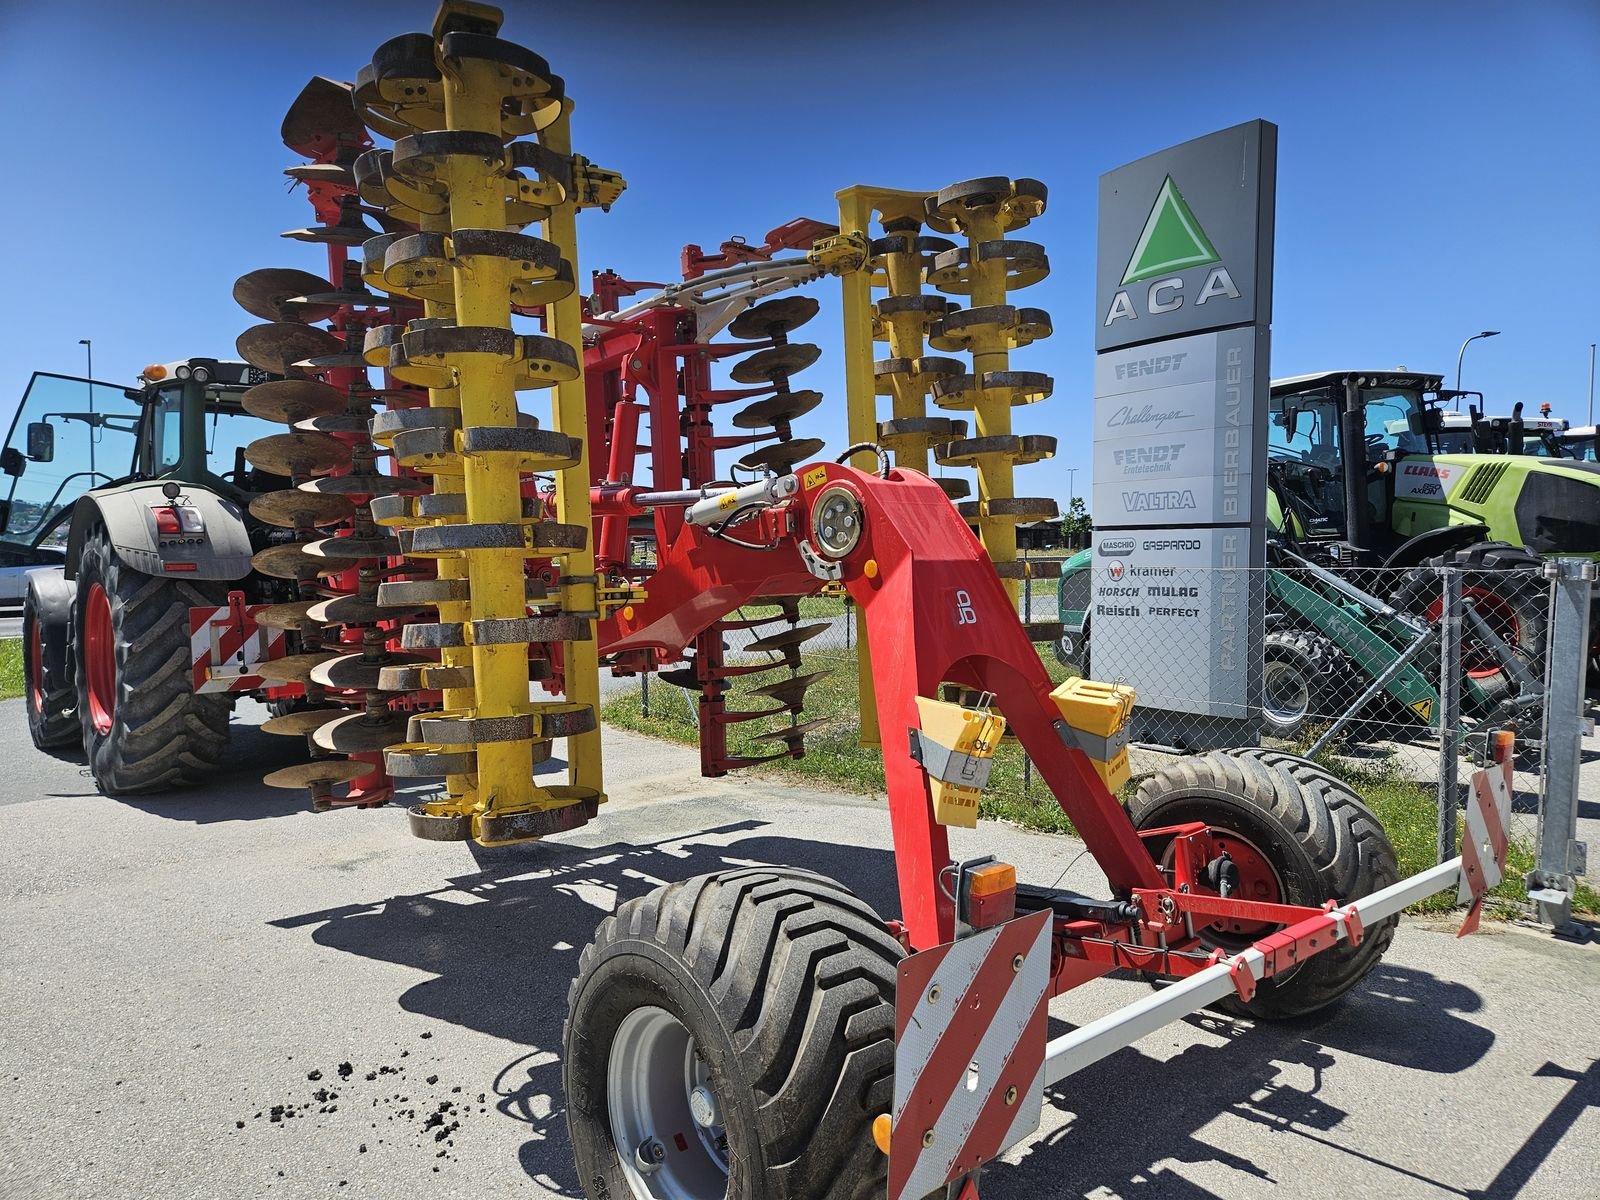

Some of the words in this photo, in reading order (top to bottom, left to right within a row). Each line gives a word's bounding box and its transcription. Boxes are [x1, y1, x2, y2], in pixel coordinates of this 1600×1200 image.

[1104, 266, 1242, 327] ACA
[1115, 353, 1187, 380] FENDT
[1106, 406, 1196, 429] Challenger
[1223, 346, 1241, 517] BIERBAUER
[1113, 444, 1186, 466] FENDT
[1123, 462, 1171, 475] Erntetechnik
[1404, 465, 1451, 479] CLAAS
[1410, 487, 1438, 496] AXION
[1122, 490, 1196, 512] VALTRA
[1103, 541, 1135, 549] MASCHIO
[1143, 540, 1201, 551] GASPARDO
[1130, 564, 1176, 577] kramer
[1098, 587, 1140, 597] HORSCH
[1147, 586, 1199, 598] MULAG
[1097, 604, 1140, 617] Reisch
[1148, 606, 1200, 618] PERFECT
[1220, 535, 1238, 672] PARTNER
